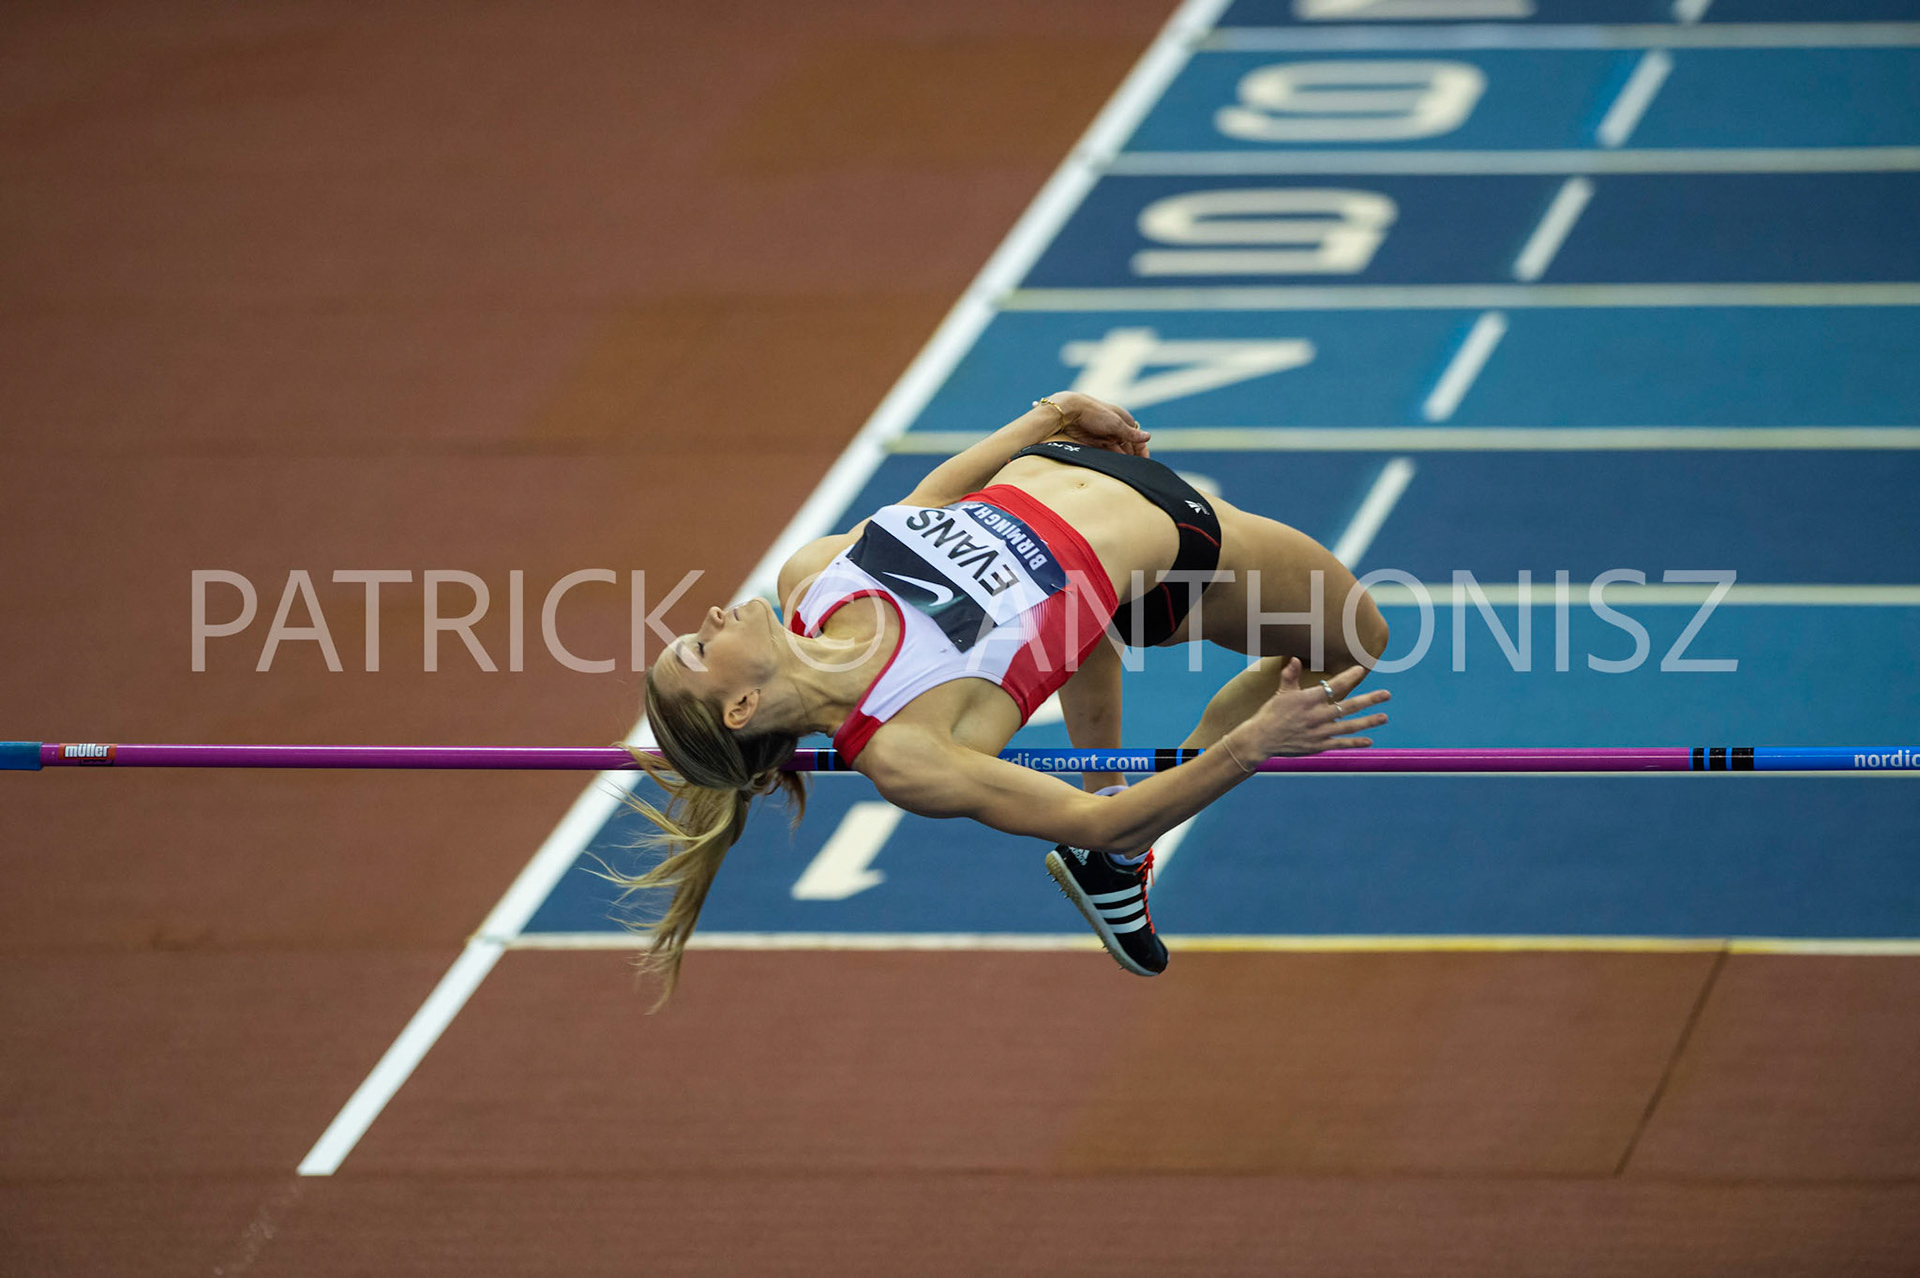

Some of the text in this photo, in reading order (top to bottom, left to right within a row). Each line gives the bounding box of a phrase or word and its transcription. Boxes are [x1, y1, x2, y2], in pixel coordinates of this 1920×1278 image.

[1213, 58, 1488, 143] 6
[1129, 187, 1398, 277] 5
[1059, 326, 1317, 411] 4
[906, 509, 1020, 597] EVANS
[64, 743, 110, 758] müller
[1002, 752, 1149, 771] dicsport.com
[790, 801, 906, 901] 1
